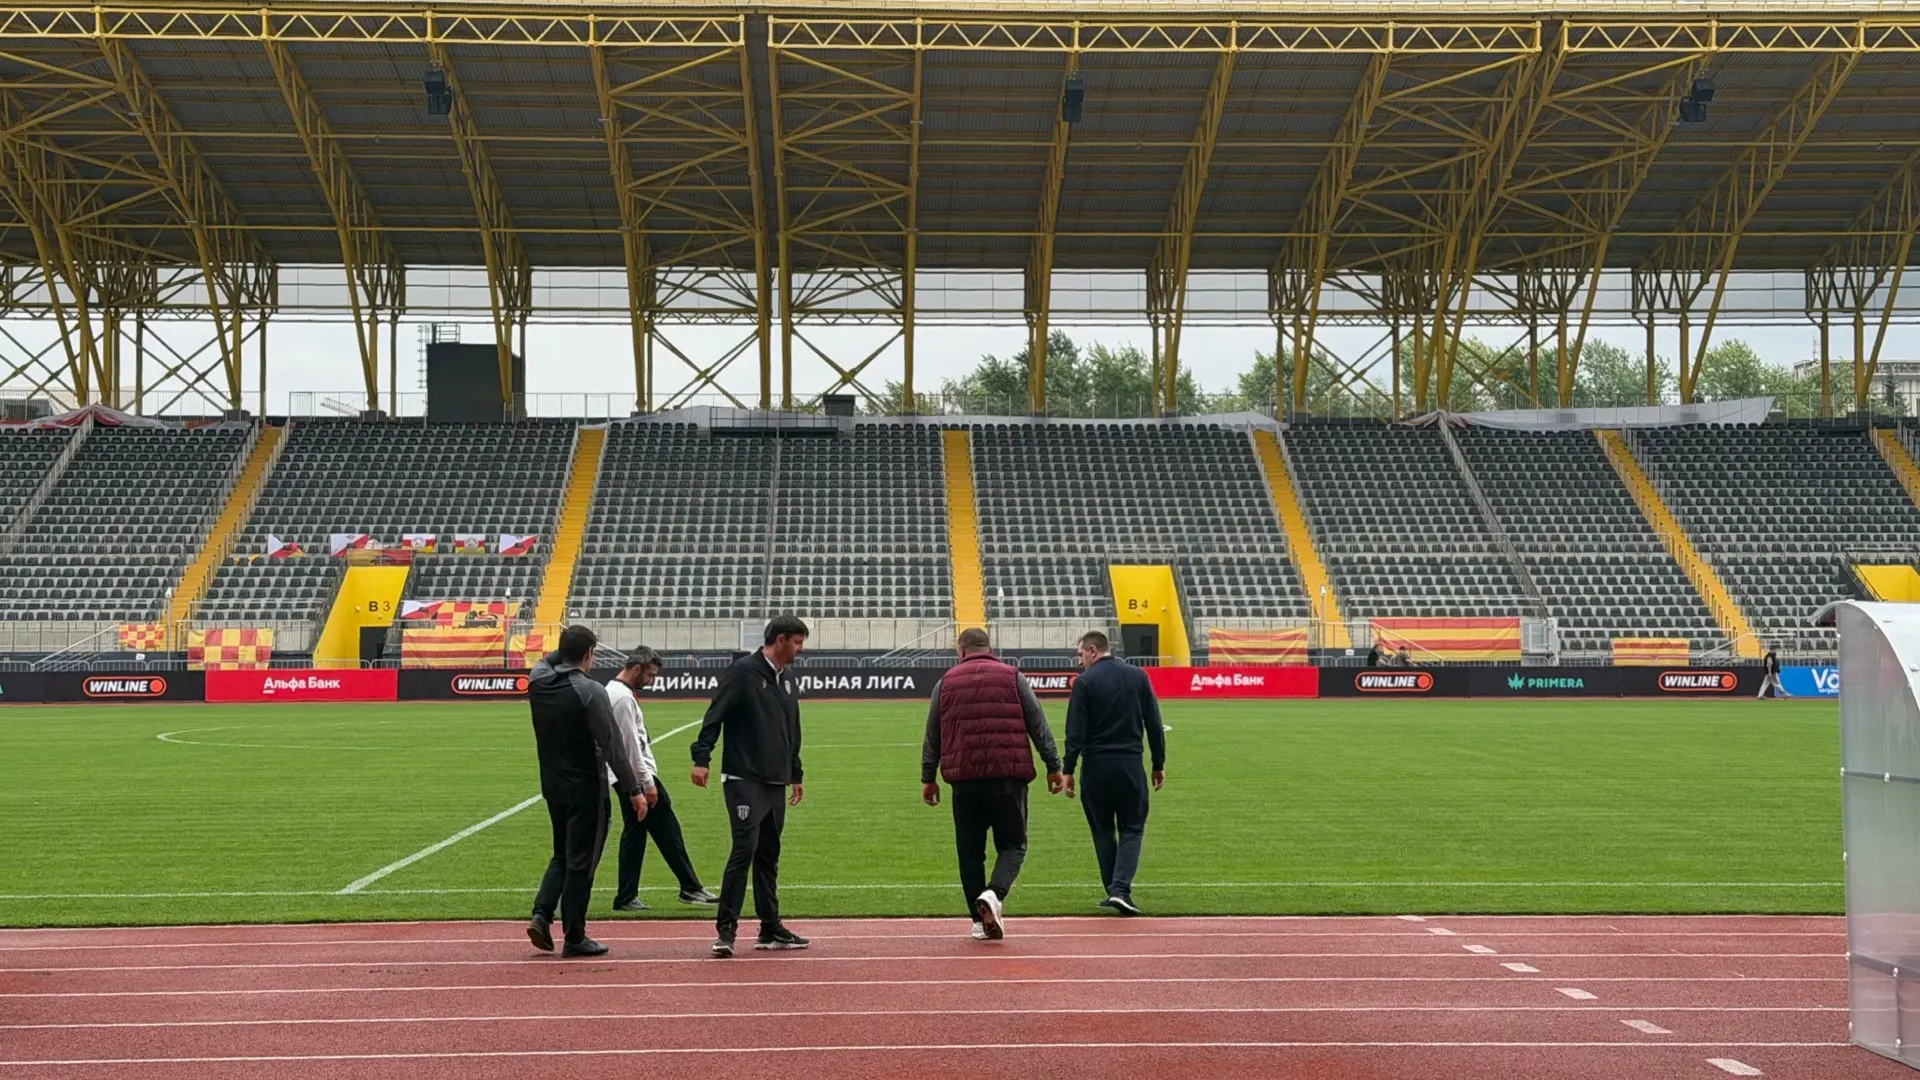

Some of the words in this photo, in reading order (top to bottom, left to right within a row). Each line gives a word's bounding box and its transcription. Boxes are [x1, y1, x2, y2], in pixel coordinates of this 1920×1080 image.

[382, 600, 391, 612] 3
[1141, 599, 1149, 610] 4
[89, 680, 149, 693] WINLINE
[263, 676, 306, 693] Альфа
[307, 676, 341, 689] Банк
[457, 678, 514, 690] WINLINE
[642, 672, 719, 692] ДИЙНА
[795, 676, 862, 690] ЛЬНАЯ
[866, 676, 916, 690] ЛИГА
[1191, 673, 1232, 690] Альфа
[1233, 673, 1265, 686] Банк
[1361, 675, 1416, 688] WINLINE
[1527, 678, 1584, 689] PRIMERA
[1665, 675, 1719, 688] WINLINE
